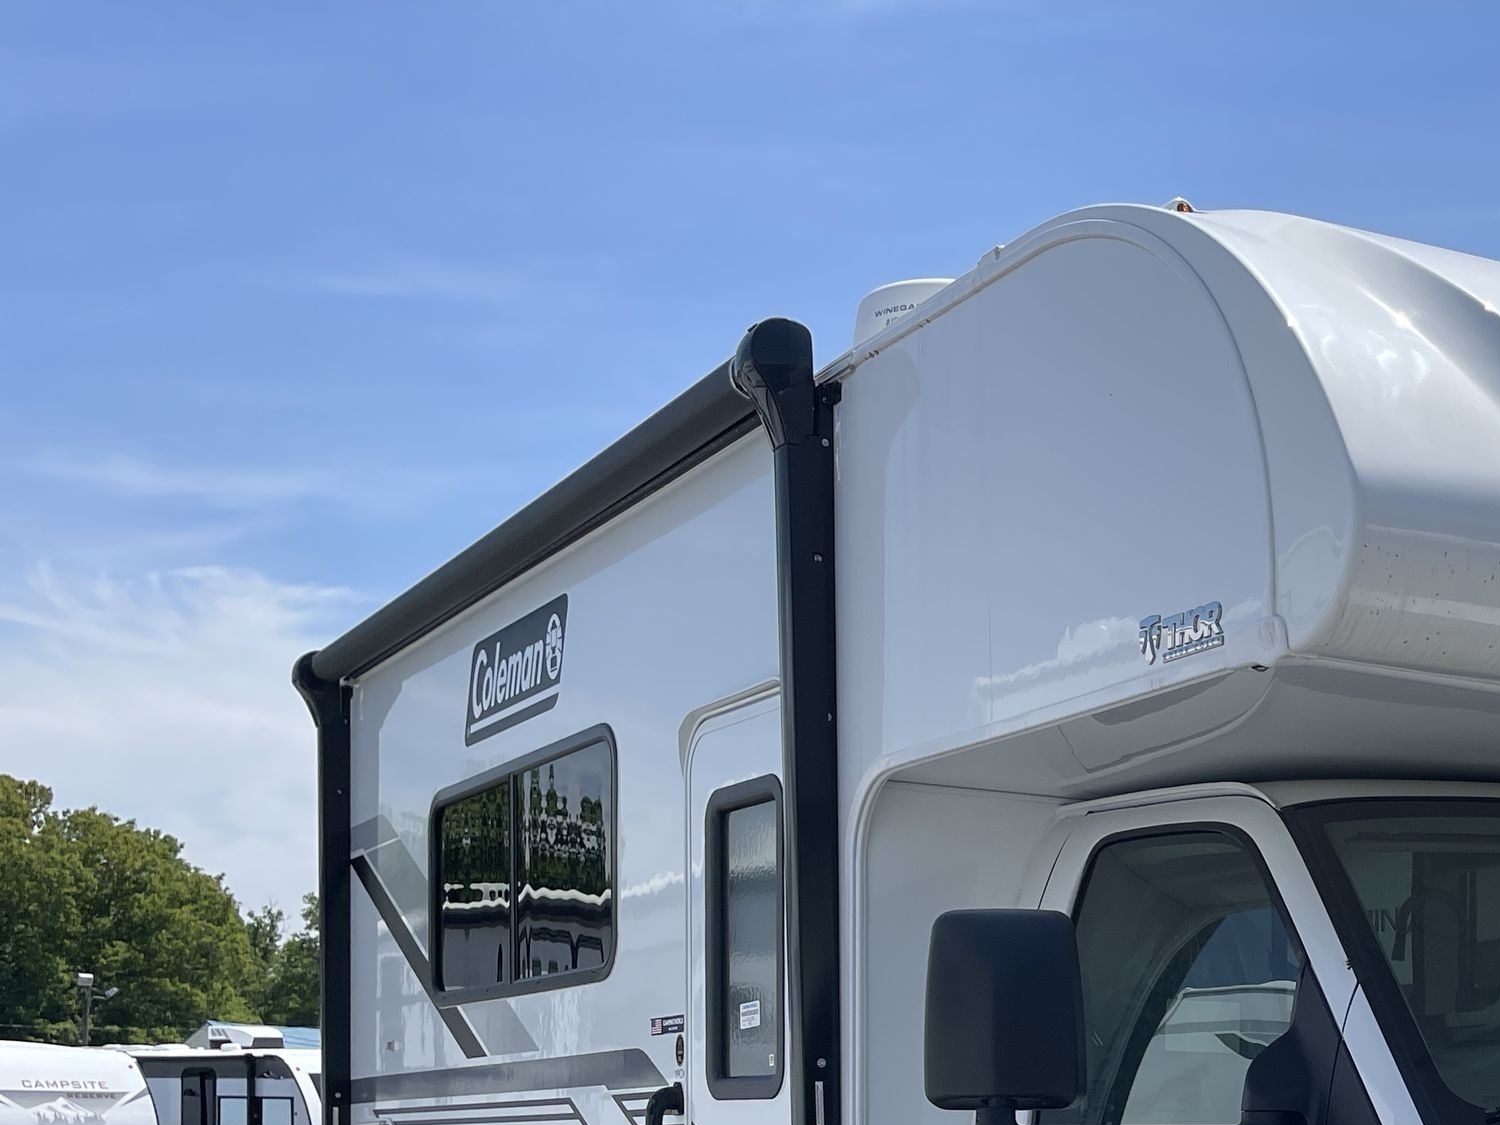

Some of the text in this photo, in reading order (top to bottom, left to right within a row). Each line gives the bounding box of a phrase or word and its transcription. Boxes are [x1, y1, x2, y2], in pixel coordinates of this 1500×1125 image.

[1162, 601, 1224, 650] THOR
[472, 641, 544, 719] Coleman
[21, 1079, 110, 1090] CAMPSITE
[67, 1092, 116, 1100] RESERVE
